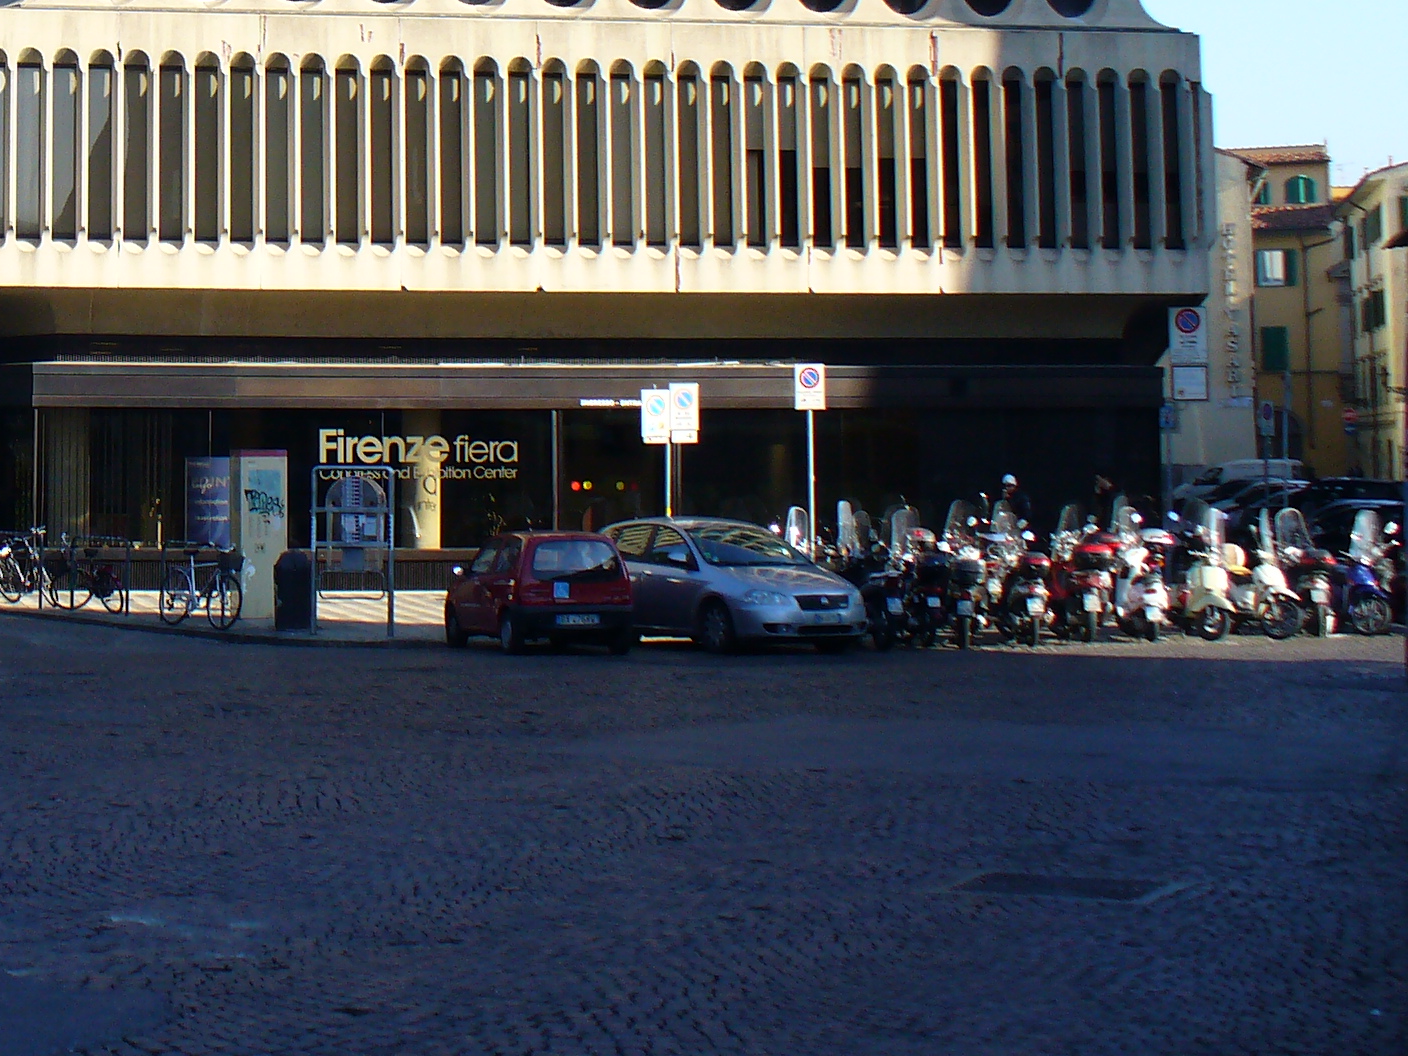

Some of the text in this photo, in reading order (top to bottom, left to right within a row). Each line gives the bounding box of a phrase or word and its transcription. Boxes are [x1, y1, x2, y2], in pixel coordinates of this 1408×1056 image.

[319, 428, 518, 464] Firenze fiera
[473, 465, 518, 480] Center
